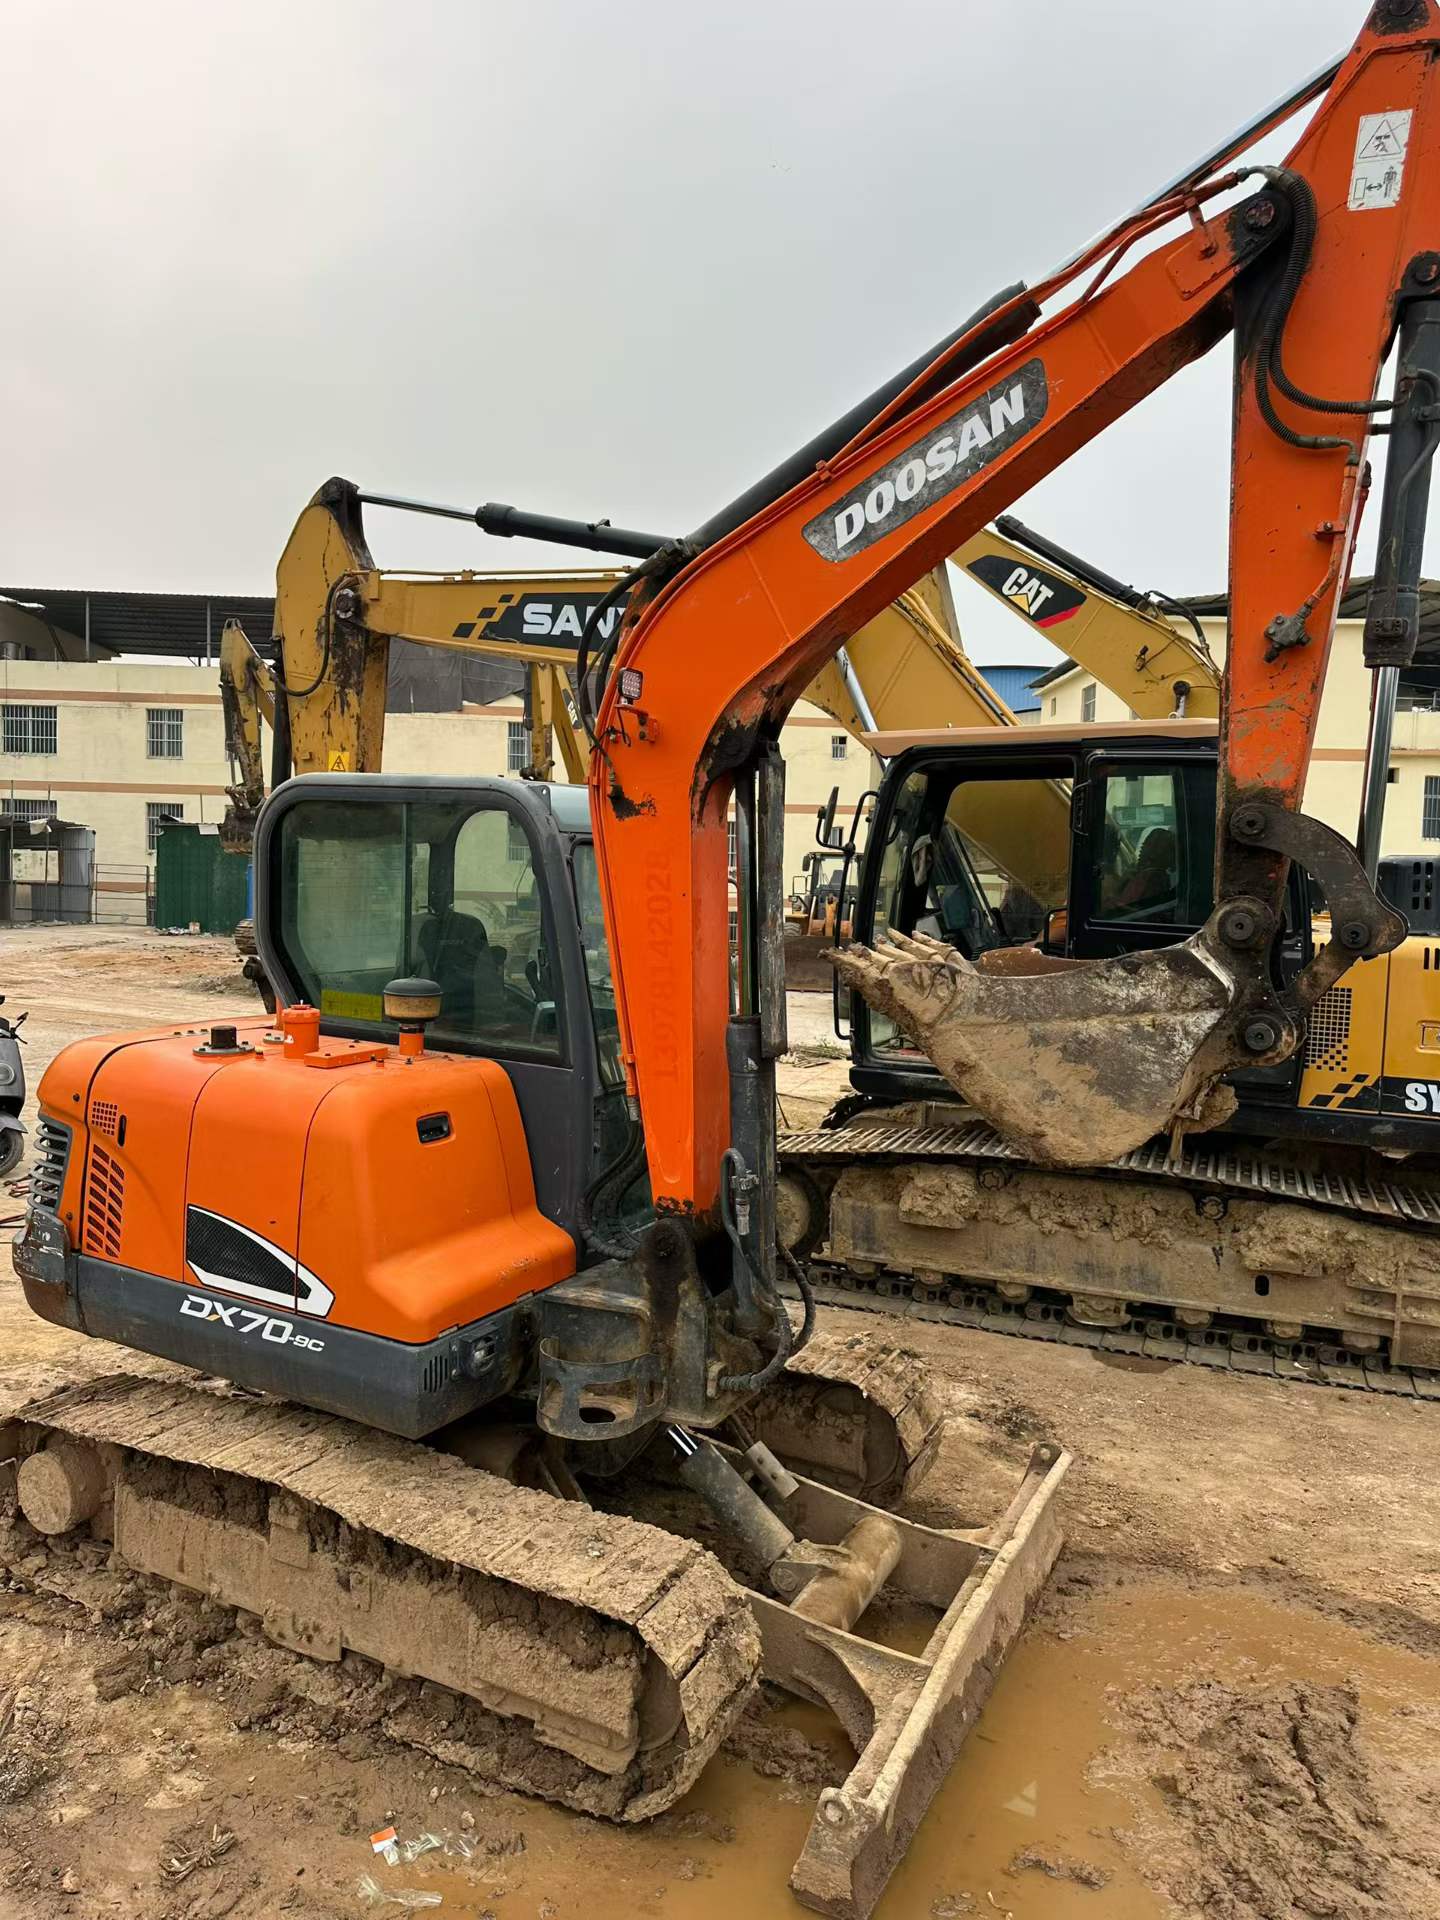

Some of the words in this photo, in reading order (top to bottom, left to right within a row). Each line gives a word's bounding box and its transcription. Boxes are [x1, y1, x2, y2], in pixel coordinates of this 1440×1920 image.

[834, 384, 1025, 550] DOOSAN
[1002, 567, 1055, 616] CAT
[179, 1294, 326, 1352] DX70-9C
